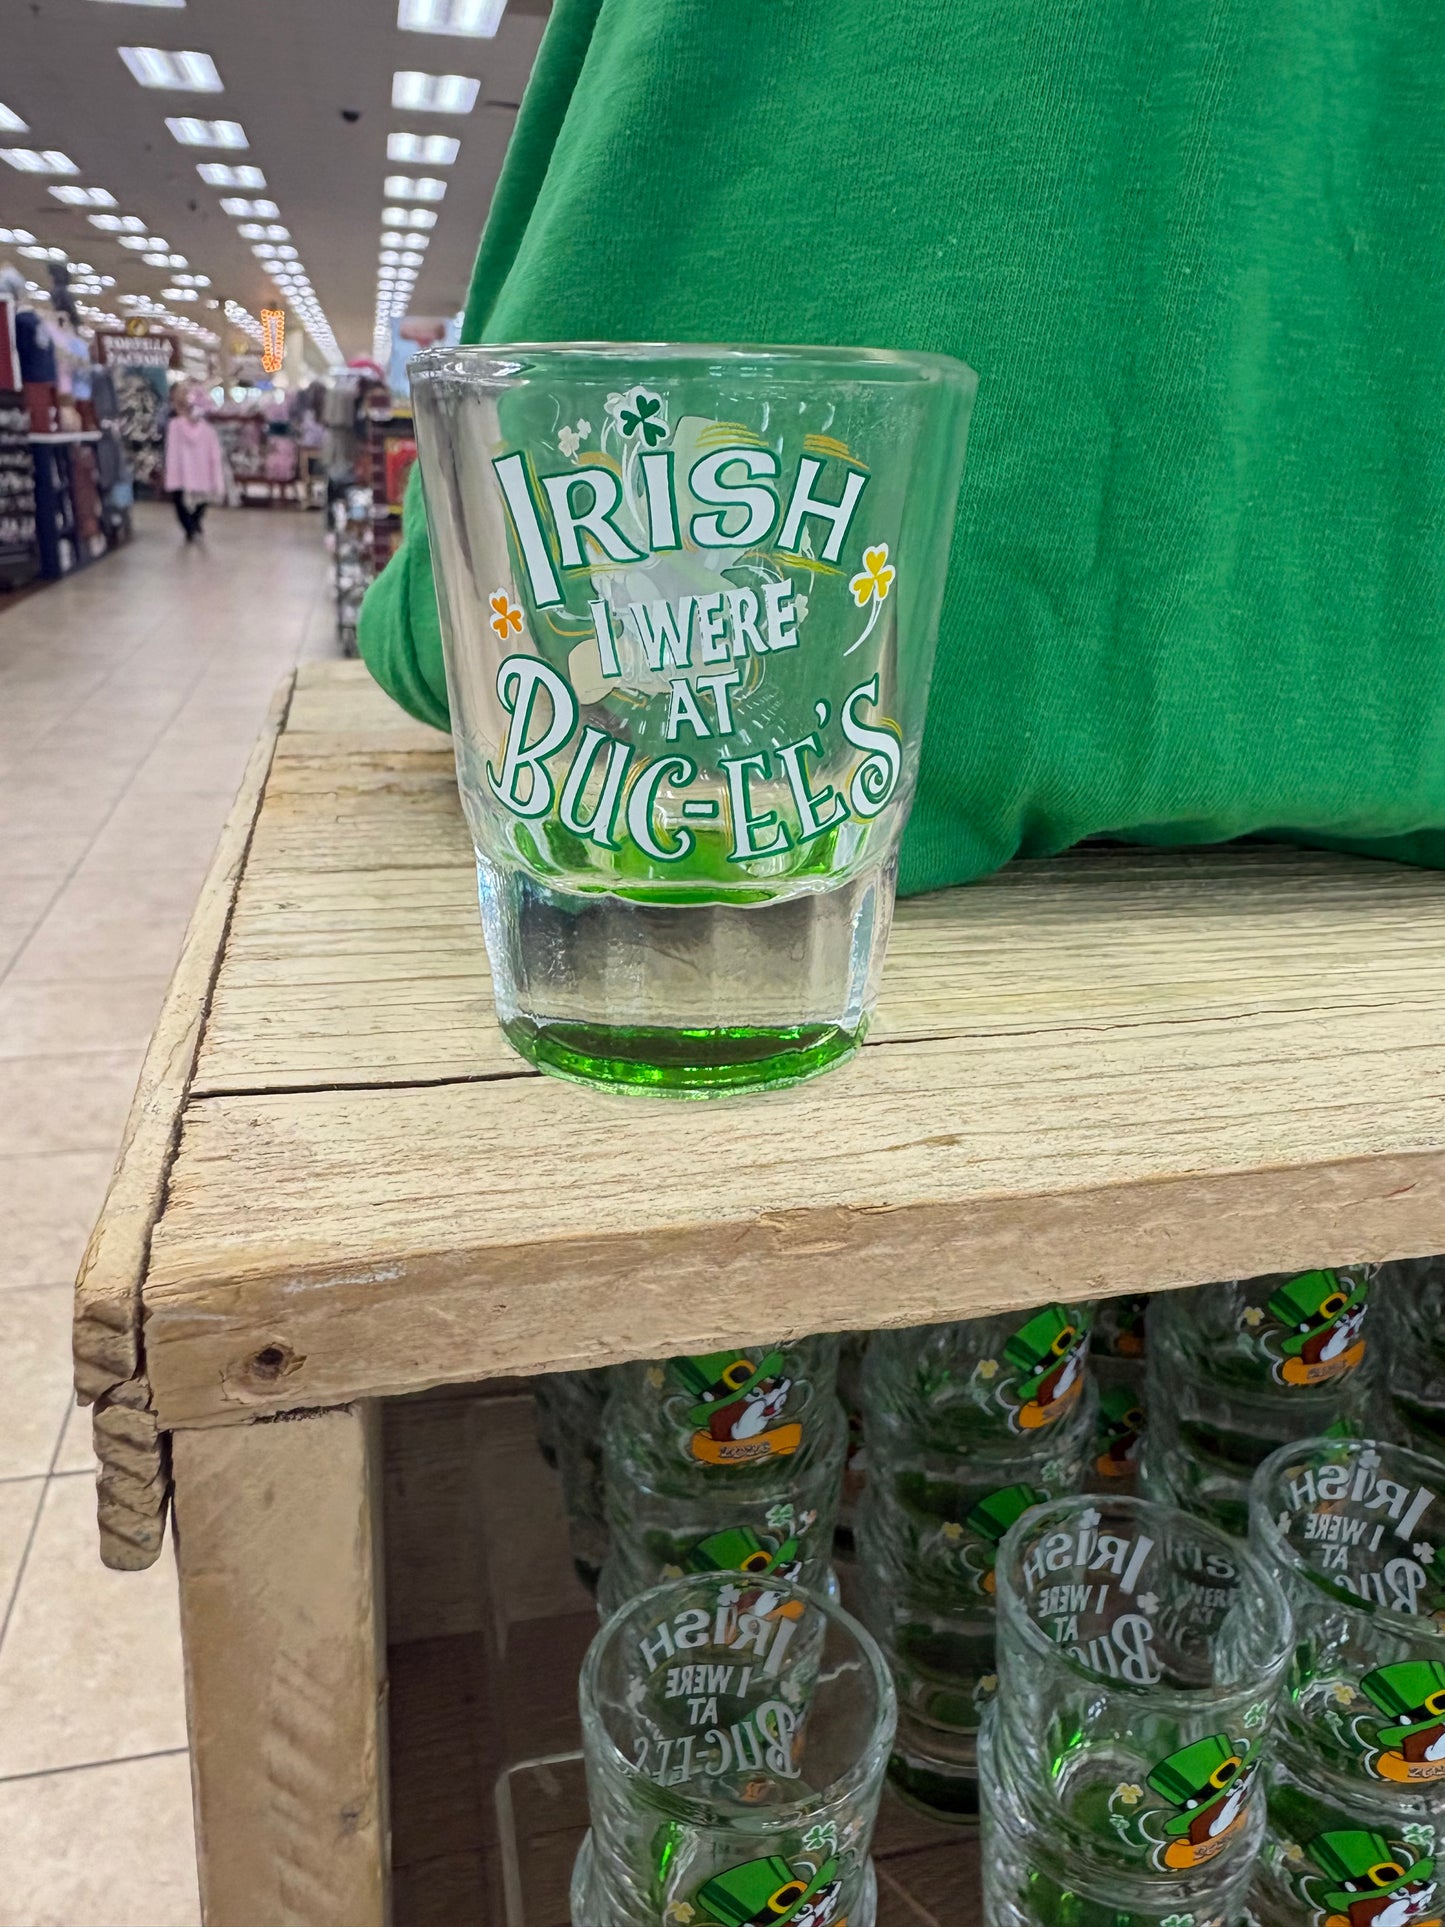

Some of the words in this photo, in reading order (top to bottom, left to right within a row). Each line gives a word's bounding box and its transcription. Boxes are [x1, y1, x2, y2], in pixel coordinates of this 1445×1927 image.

[493, 447, 871, 611] IRISH
[588, 599, 621, 679] I
[630, 578, 800, 671] WERE
[487, 654, 902, 863] BUC-EE'S
[666, 670, 740, 742] AT
